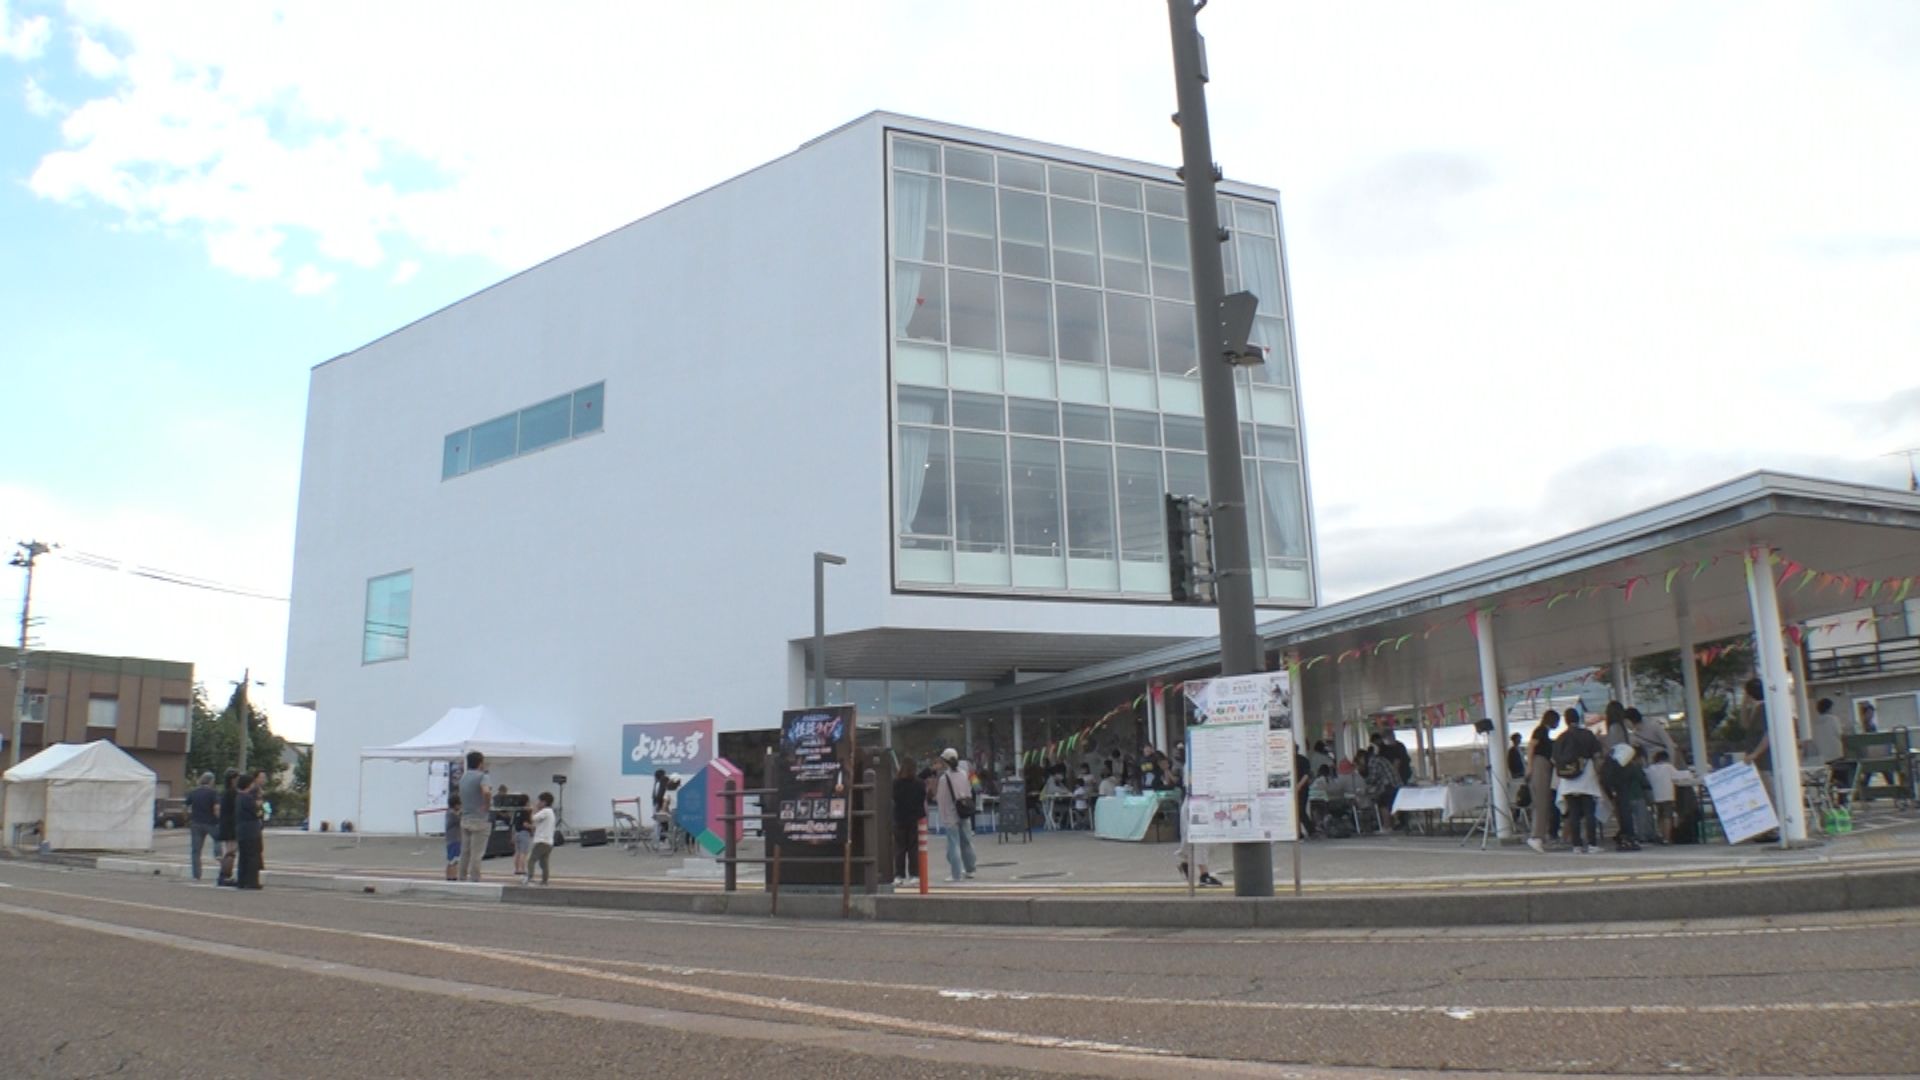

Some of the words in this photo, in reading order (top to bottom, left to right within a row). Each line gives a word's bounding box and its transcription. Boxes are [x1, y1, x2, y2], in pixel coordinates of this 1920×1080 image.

[631, 730, 704, 762] よりふぇす
